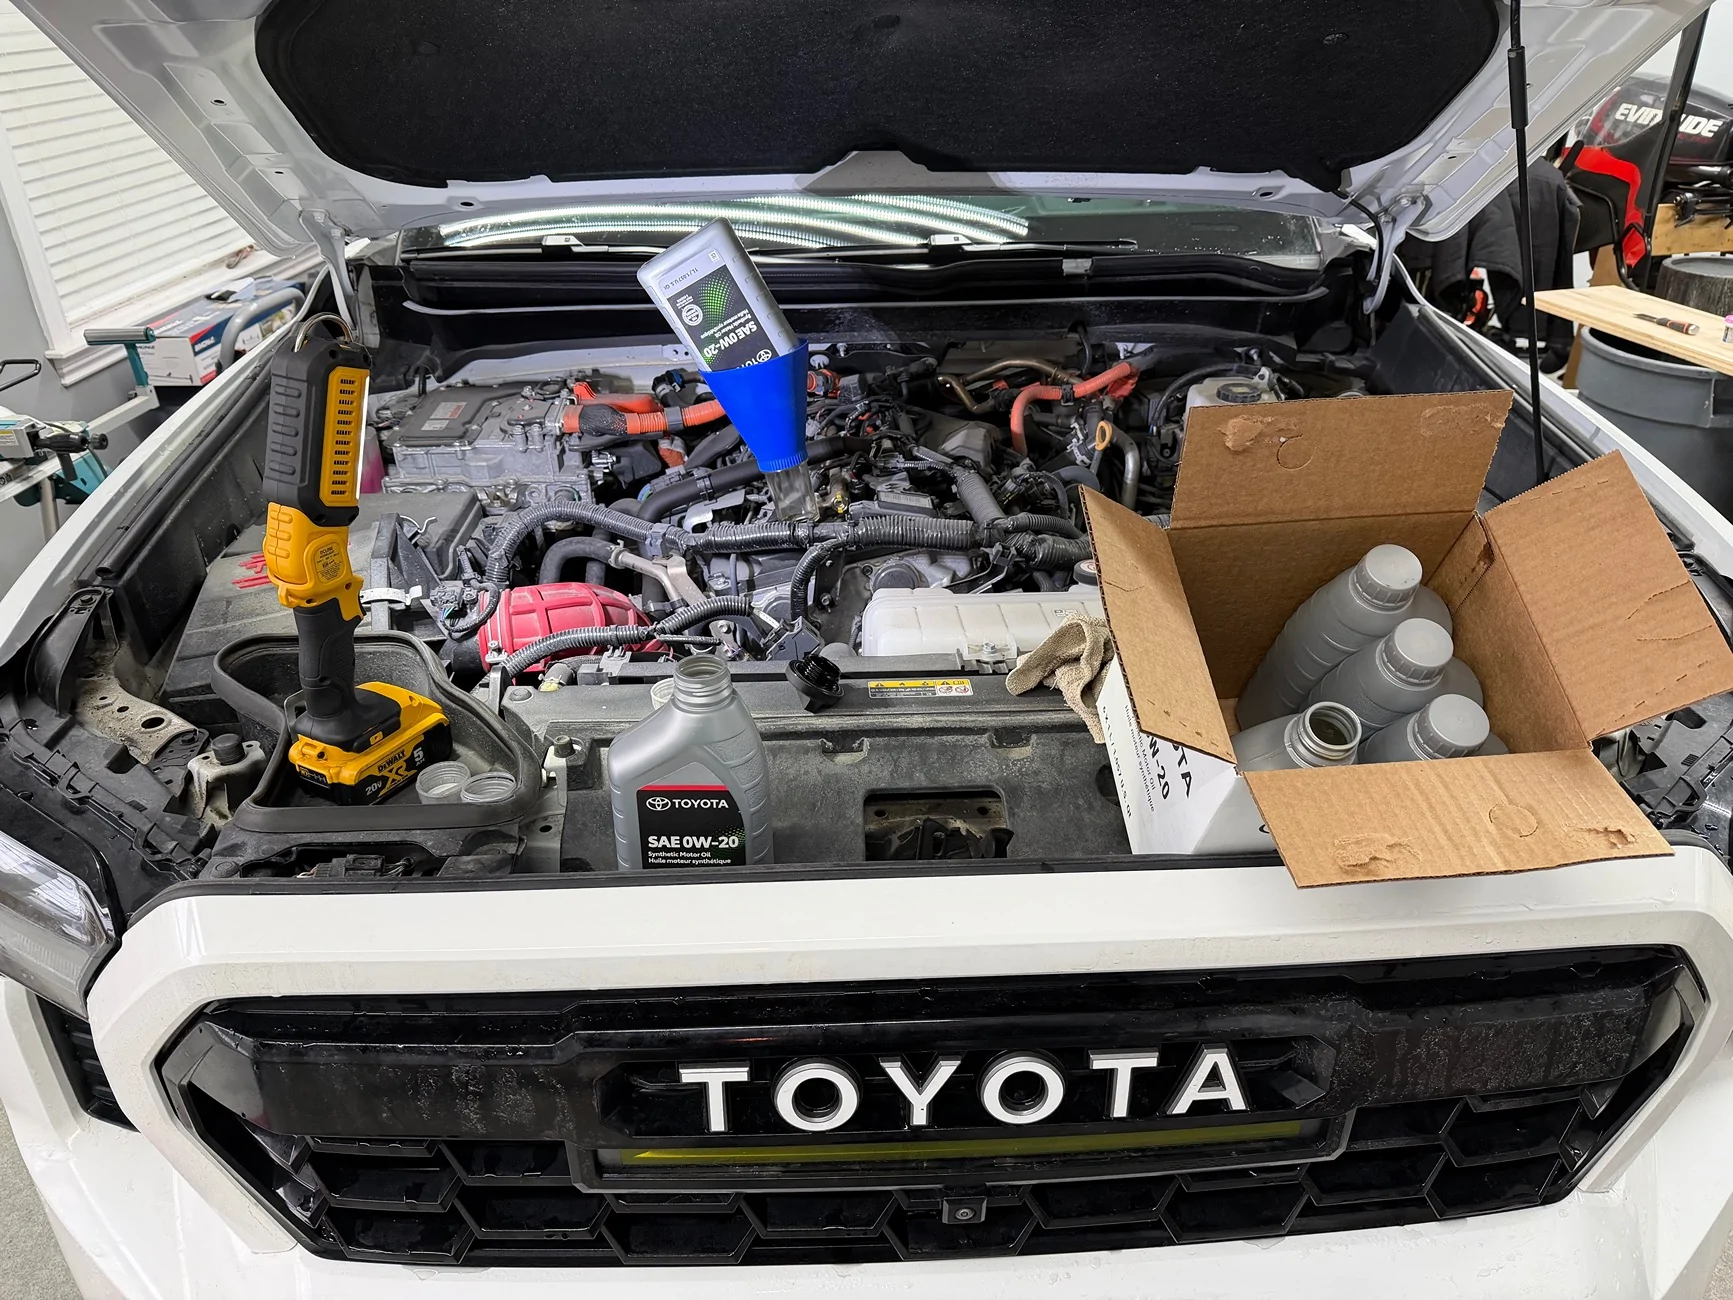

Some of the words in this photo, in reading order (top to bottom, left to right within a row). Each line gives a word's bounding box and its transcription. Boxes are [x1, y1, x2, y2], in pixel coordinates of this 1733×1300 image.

[736, 321, 757, 340] SAE
[703, 333, 738, 357] 0W-20
[413, 747, 424, 761] 5
[1124, 705, 1132, 727] Huile
[1130, 728, 1141, 759] moteur
[1138, 761, 1155, 812] synthétique
[1141, 749, 1151, 775] Motor
[1146, 733, 1170, 799] W-20
[672, 799, 729, 809] TOYOTA
[648, 835, 681, 848] SAE
[682, 836, 739, 848] 0W-20
[679, 1043, 1250, 1133] TOYOTA
